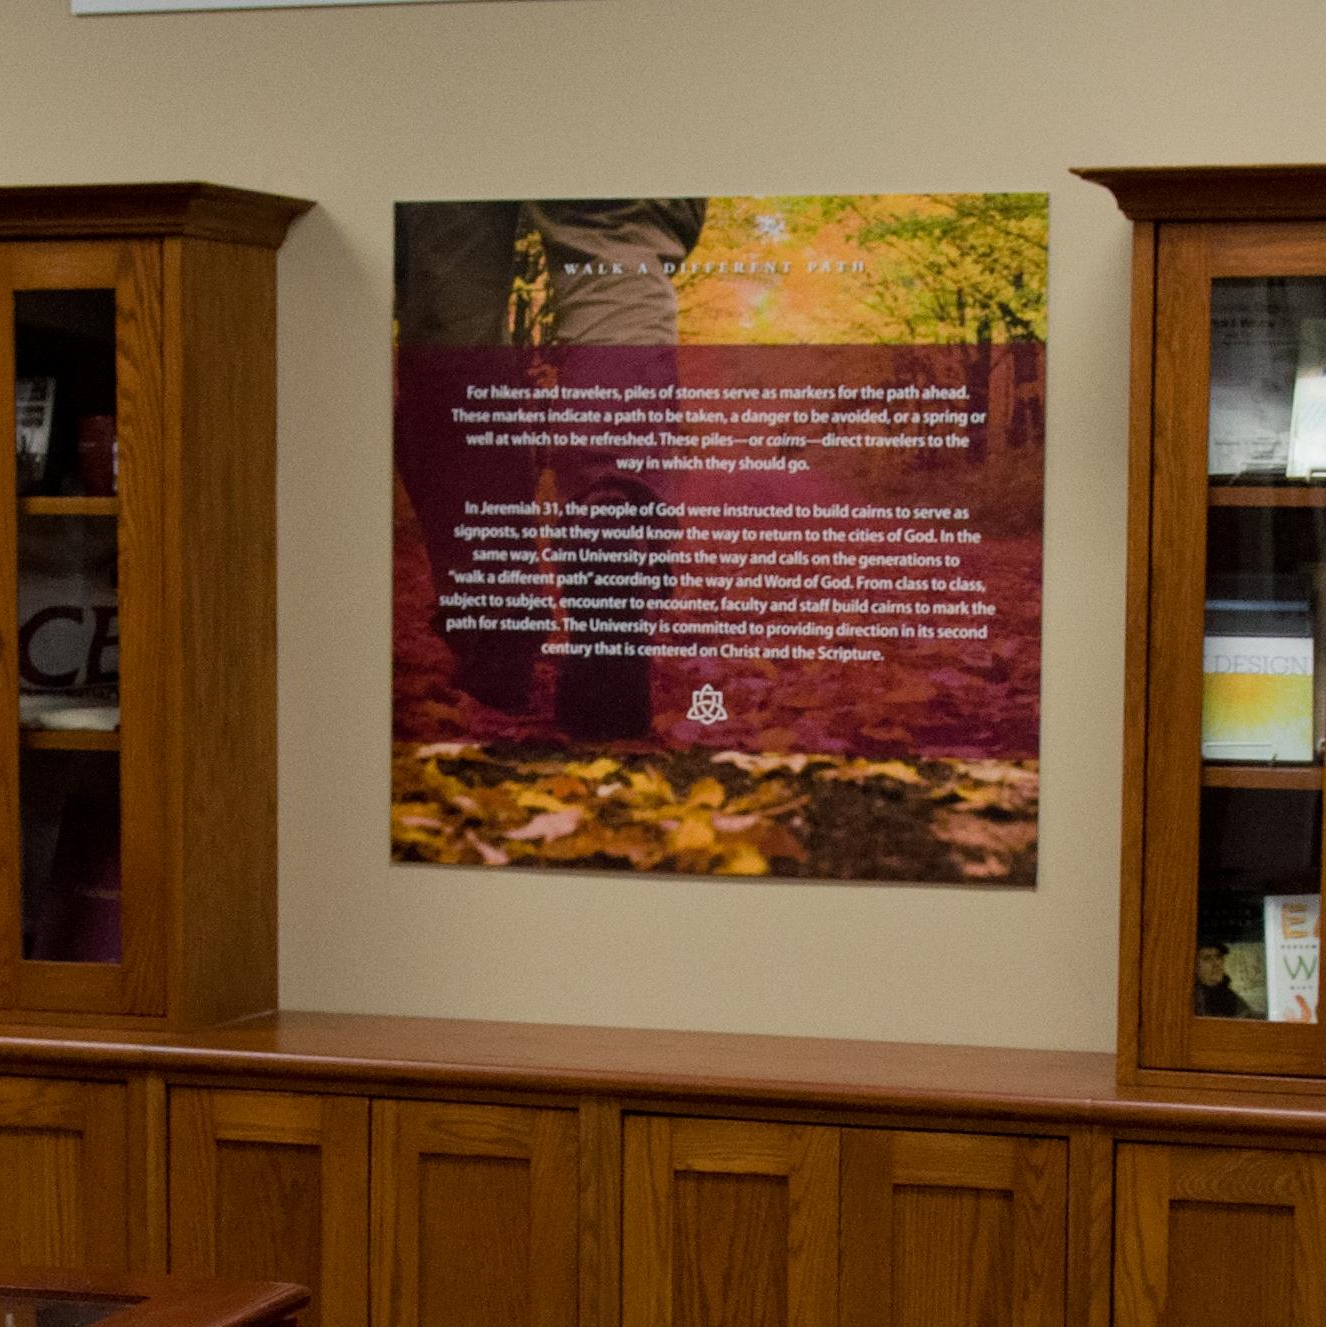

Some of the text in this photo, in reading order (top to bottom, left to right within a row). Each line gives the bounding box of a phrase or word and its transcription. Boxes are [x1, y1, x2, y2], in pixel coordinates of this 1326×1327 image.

[564, 261, 866, 275] WALK A DIFFERENT PATH
[467, 385, 970, 402] For hikers and travelers, piles of stones serve markers for the path ahead.
[451, 408, 968, 426] These markers indicate path to be taken, danger to be avoided, spring
[466, 432, 970, 448] well which to be refreshed. These travelers to the
[616, 456, 810, 473] way in which they should go.
[480, 502, 951, 519] Jeremiah 31, the people of God were instructed to build cairns to serve
[454, 525, 981, 544] signposts, that they would know the way to return to the cities of God. the
[473, 549, 960, 569] same way, Cairn University points the way and calls on the generations to
[497, 571, 554, 585] different
[594, 572, 661, 589] according
[663, 573, 678, 587] to
[680, 573, 703, 588] the
[705, 577, 733, 590] way
[736, 574, 762, 588] and
[764, 575, 801, 589] Word
[803, 575, 819, 589] of
[821, 575, 853, 590] God.
[857, 576, 893, 590] From
[895, 576, 929, 591] class
[931, 577, 947, 591] to
[949, 577, 986, 594] class,
[439, 594, 996, 614] subject to subject, encounter to encounter, faculty and staff build cairns to mark the
[446, 617, 988, 638] path for students. The University committed to providing direction its second
[541, 641, 884, 663] century that centered Christ and the Scripture.
[1214, 655, 1308, 674] DESIGN
